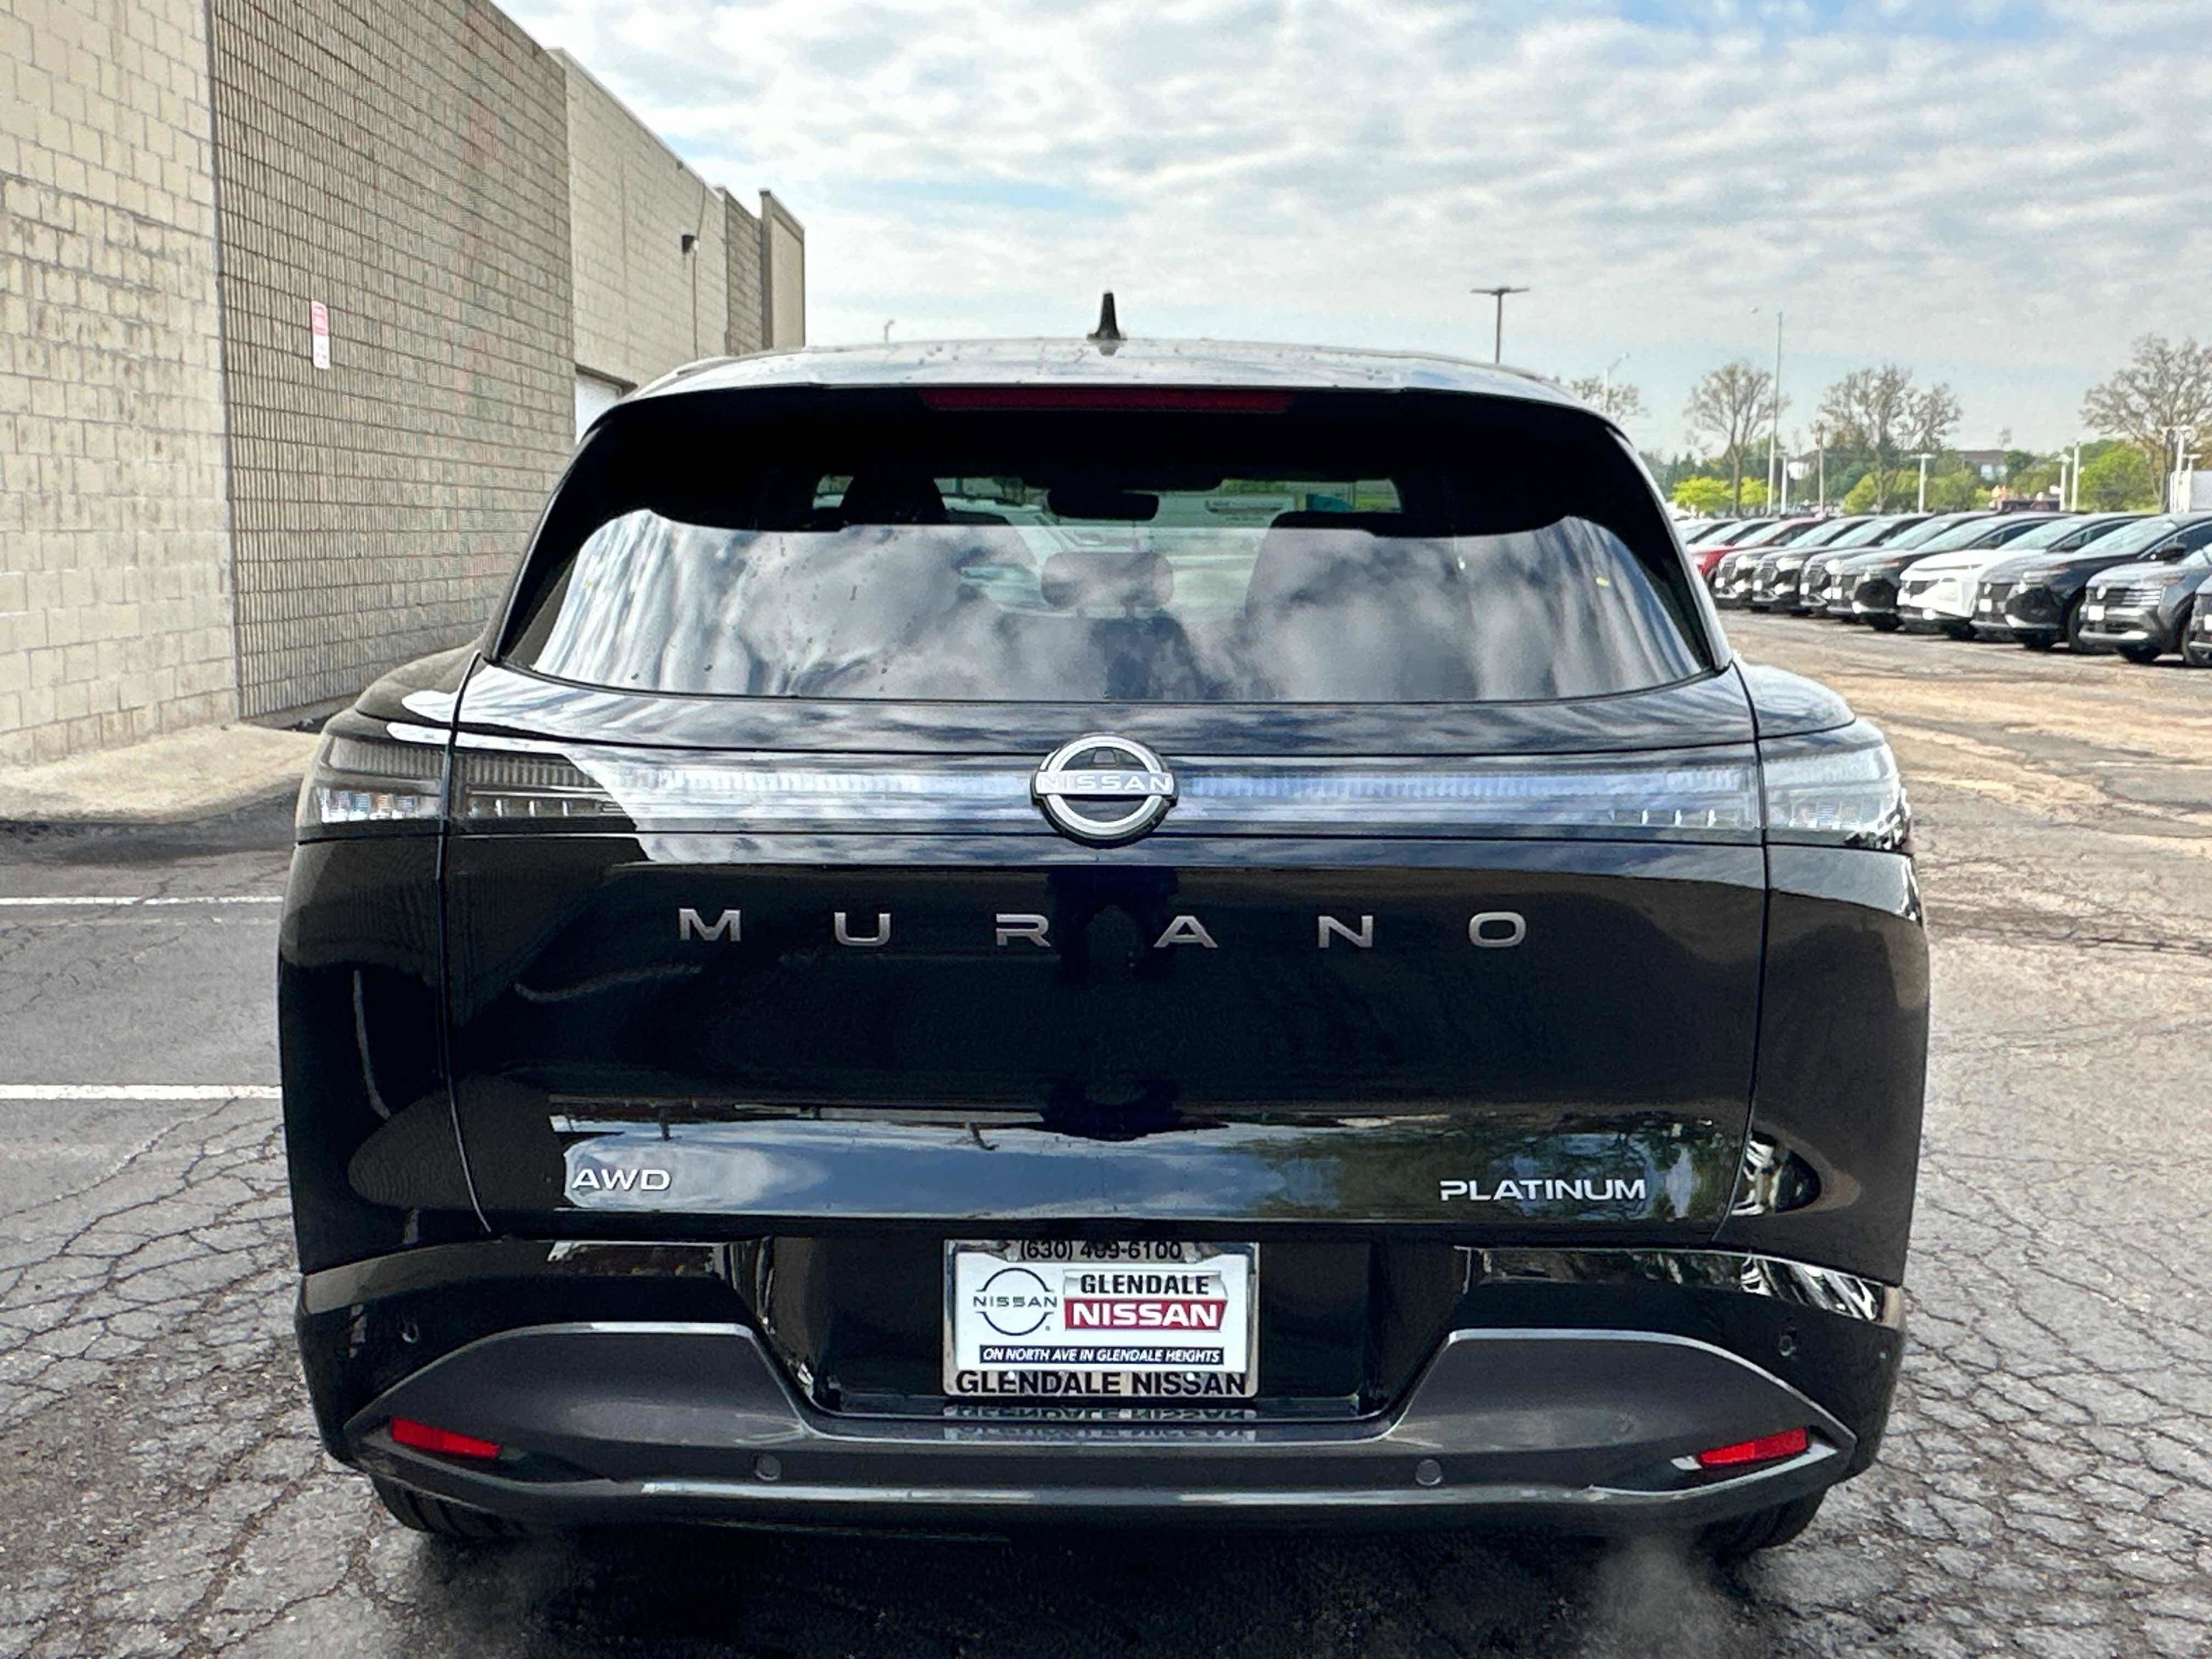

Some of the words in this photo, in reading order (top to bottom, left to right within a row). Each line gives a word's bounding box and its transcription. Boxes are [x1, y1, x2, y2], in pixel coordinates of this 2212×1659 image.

[1039, 775, 1171, 791] NISSAN
[679, 908, 1527, 949] MURANO
[571, 1169, 671, 1190] AWD
[1440, 1179, 1645, 1201] PLATINUM
[1020, 1240, 1073, 1260] (630)
[1081, 1274, 1209, 1295] GLENDALE
[973, 1296, 1057, 1308] NISSAN
[1073, 1302, 1217, 1327] NISSAN
[984, 1347, 1003, 1361] ON
[1006, 1348, 1051, 1361] NORTH
[1052, 1348, 1077, 1361] AVE
[1079, 1349, 1094, 1362] IN
[1097, 1349, 1163, 1362] GLENDALE
[1165, 1350, 1220, 1363] HEIGHTS
[956, 1370, 1121, 1394] GLENDALE
[1132, 1372, 1246, 1395] NISSAN
